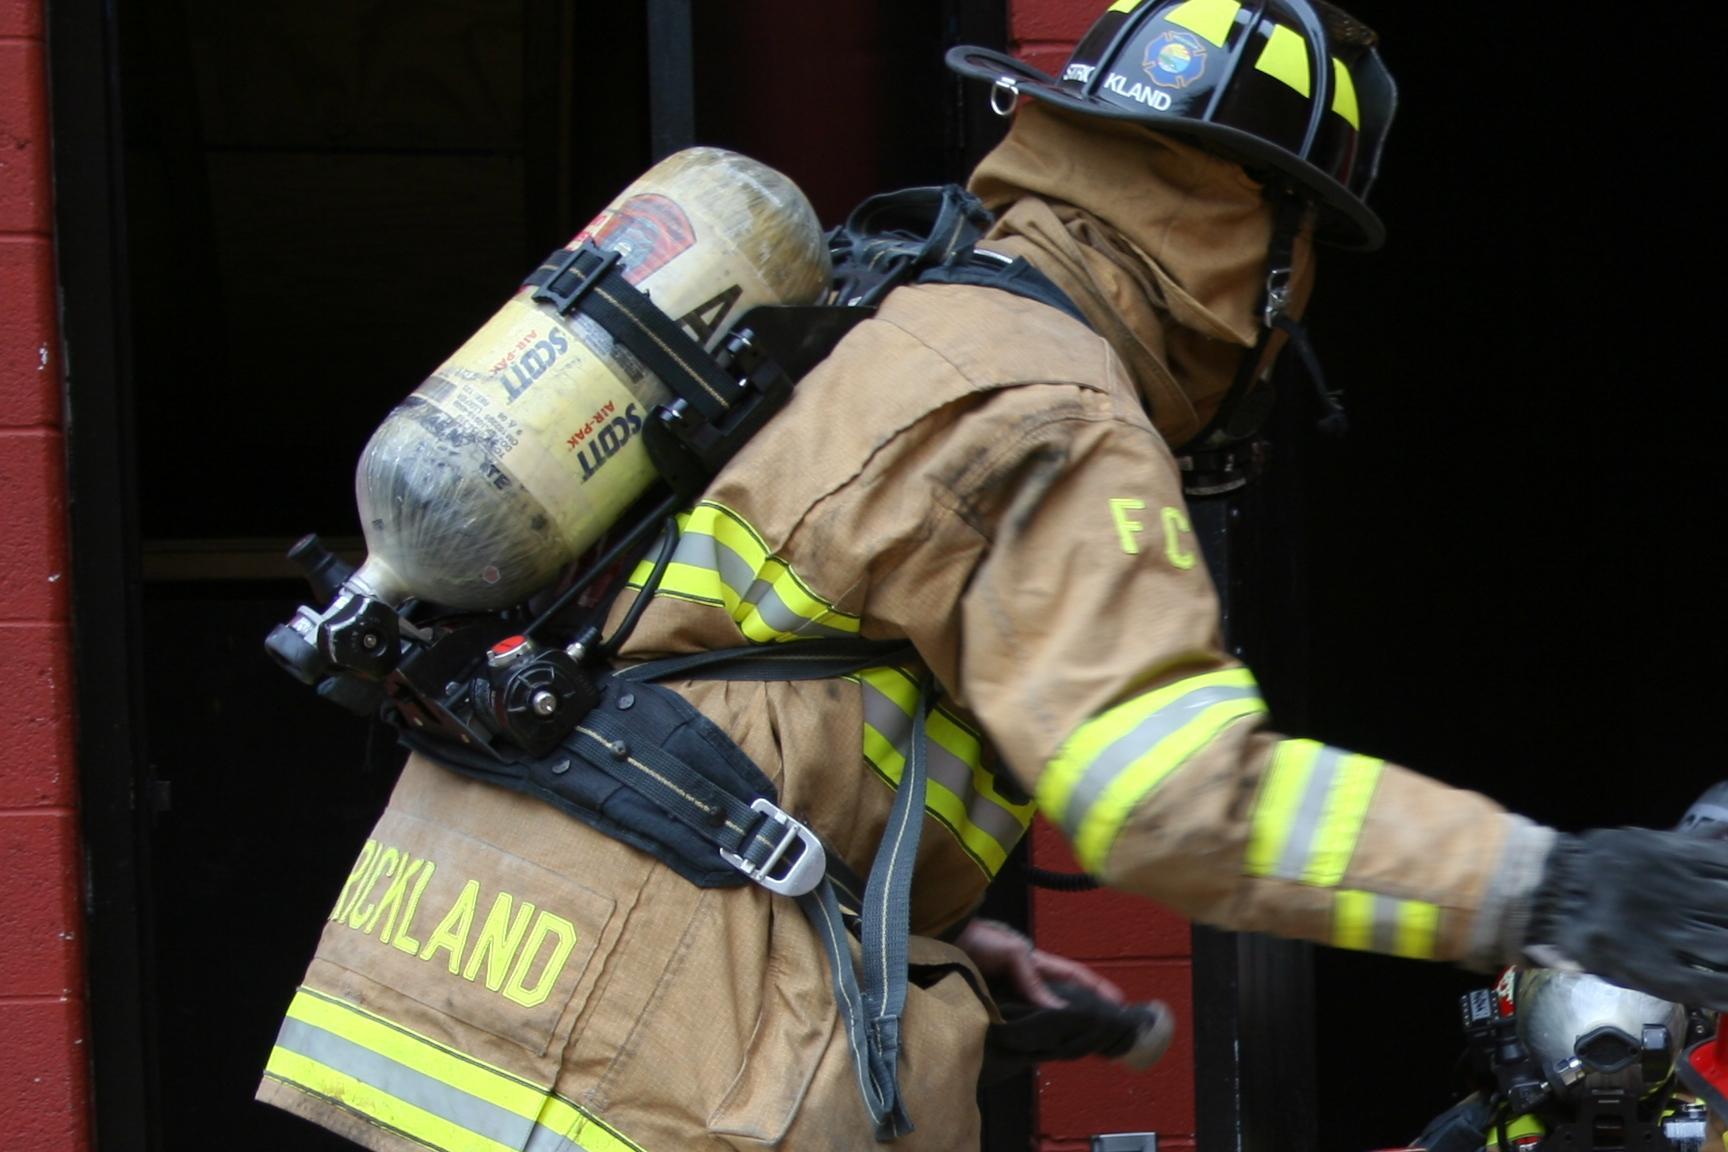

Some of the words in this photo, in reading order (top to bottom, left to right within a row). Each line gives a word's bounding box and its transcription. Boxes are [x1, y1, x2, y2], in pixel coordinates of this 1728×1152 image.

[489, 330, 537, 375] AIR-PAK
[501, 327, 568, 404] SCOTT
[567, 400, 616, 448] AIR-PAK
[577, 403, 642, 483] SCOTT
